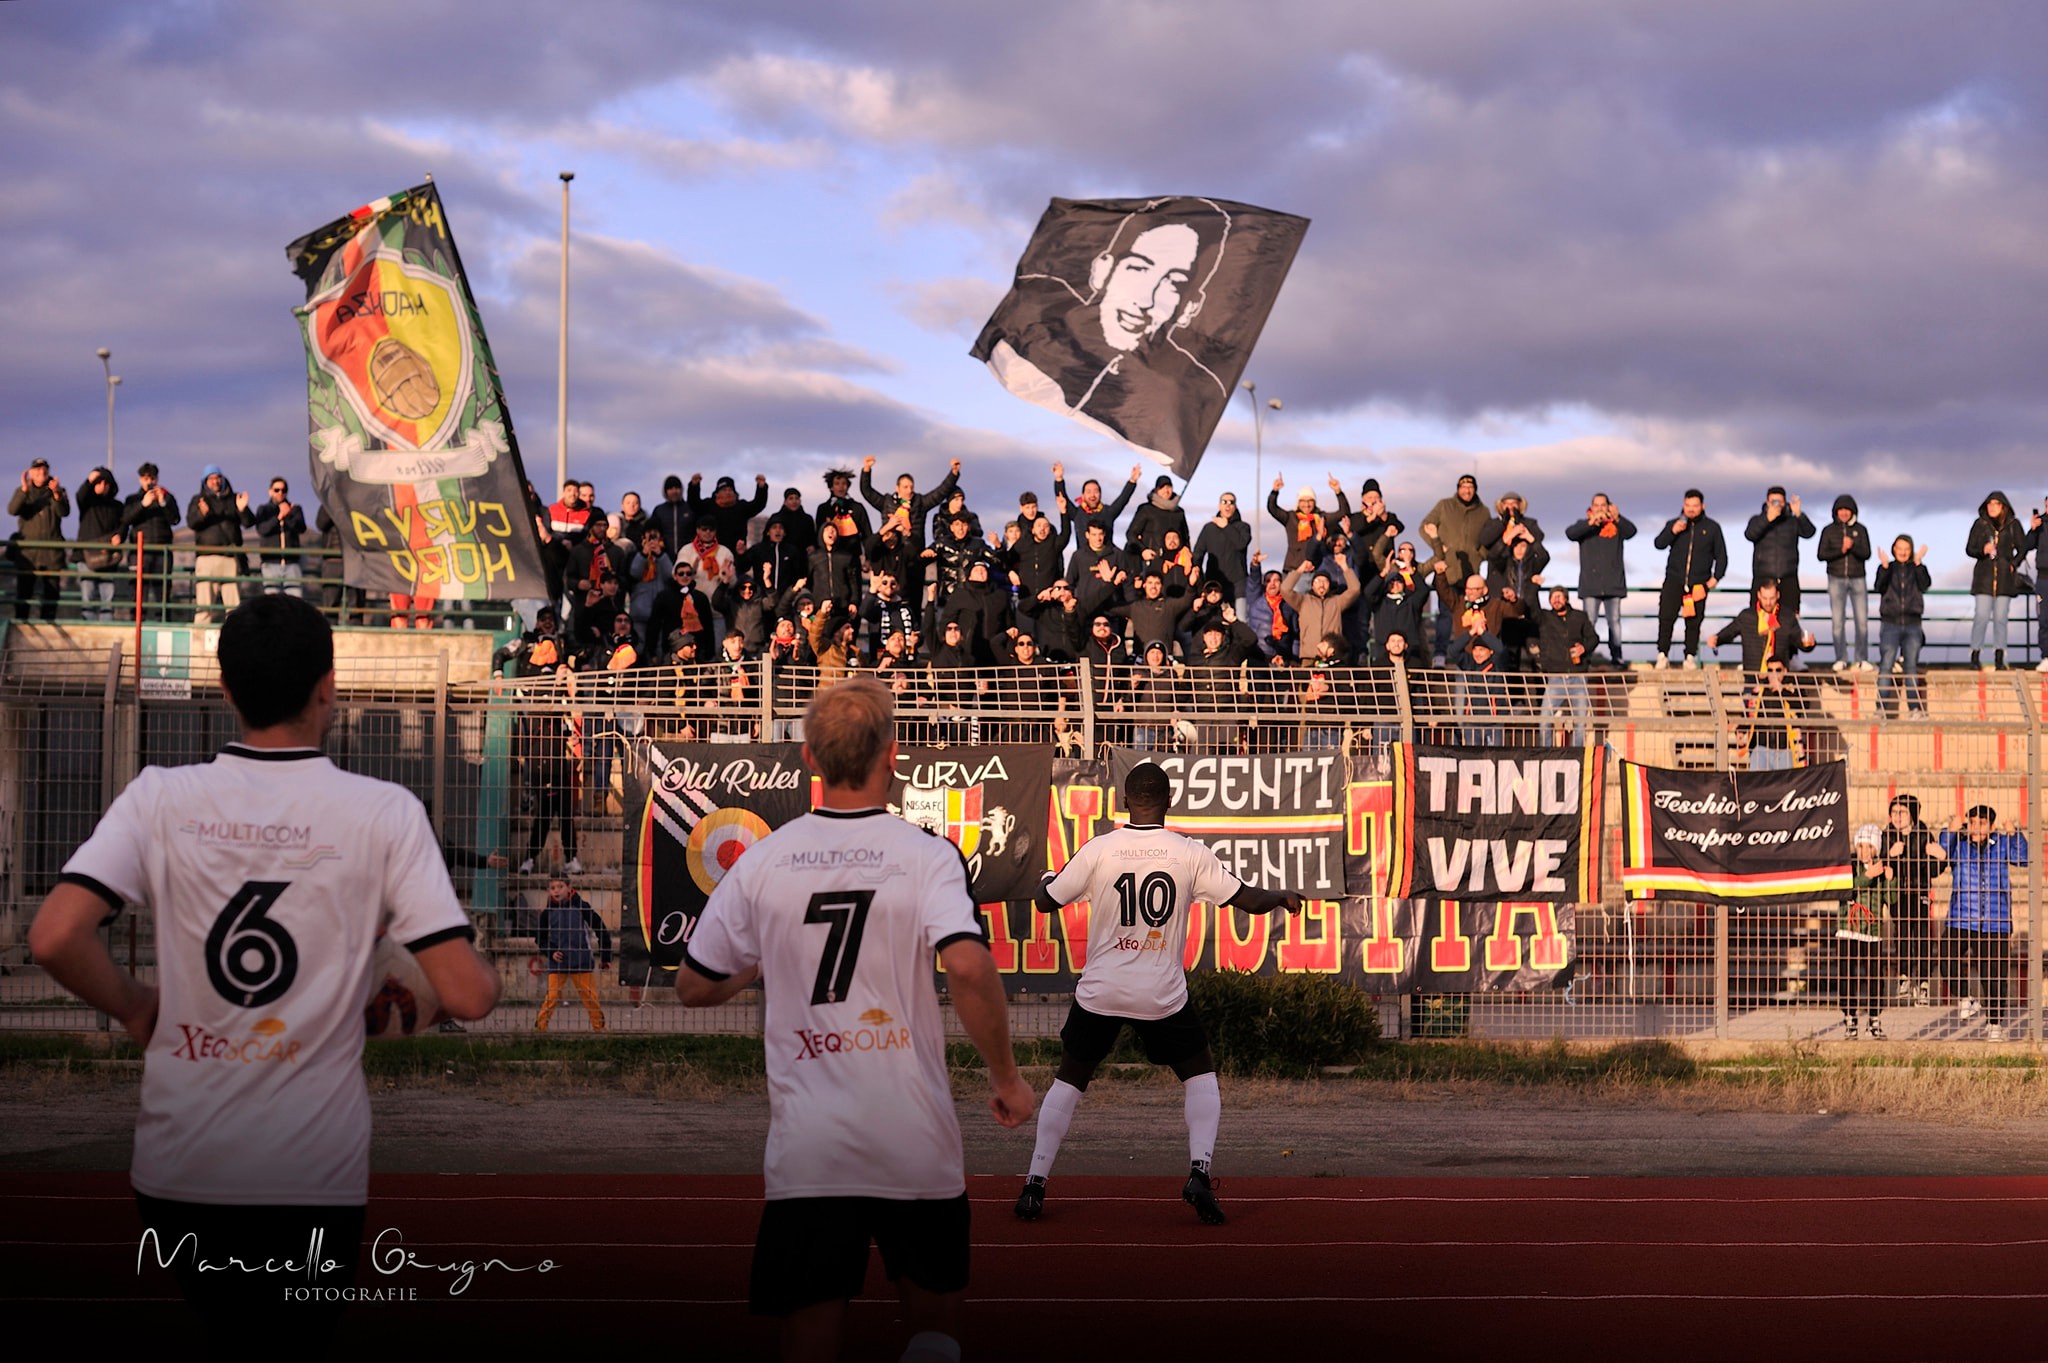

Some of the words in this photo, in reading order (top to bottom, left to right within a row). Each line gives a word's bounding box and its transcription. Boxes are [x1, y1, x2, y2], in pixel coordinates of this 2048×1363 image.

[661, 757, 718, 791] Old
[720, 759, 801, 797] Rules
[1134, 756, 1335, 811] SSENTI
[1418, 758, 1581, 815] TANO
[905, 800, 931, 811] NISSA
[932, 800, 944, 812] FC
[1654, 790, 1738, 815] Teschio
[1743, 800, 1759, 815] e
[1764, 787, 1842, 813] Anciu
[199, 822, 312, 843] MULTICOM
[1664, 826, 1745, 853] sempre
[1747, 830, 1791, 845] con
[1792, 818, 1835, 841] noi
[791, 848, 884, 865] MULTICOM
[1120, 849, 1168, 857] MULTICOM
[1427, 838, 1567, 893] VIVE
[1113, 871, 1177, 928] 10
[205, 881, 298, 1008] 6
[804, 889, 876, 1006] 7
